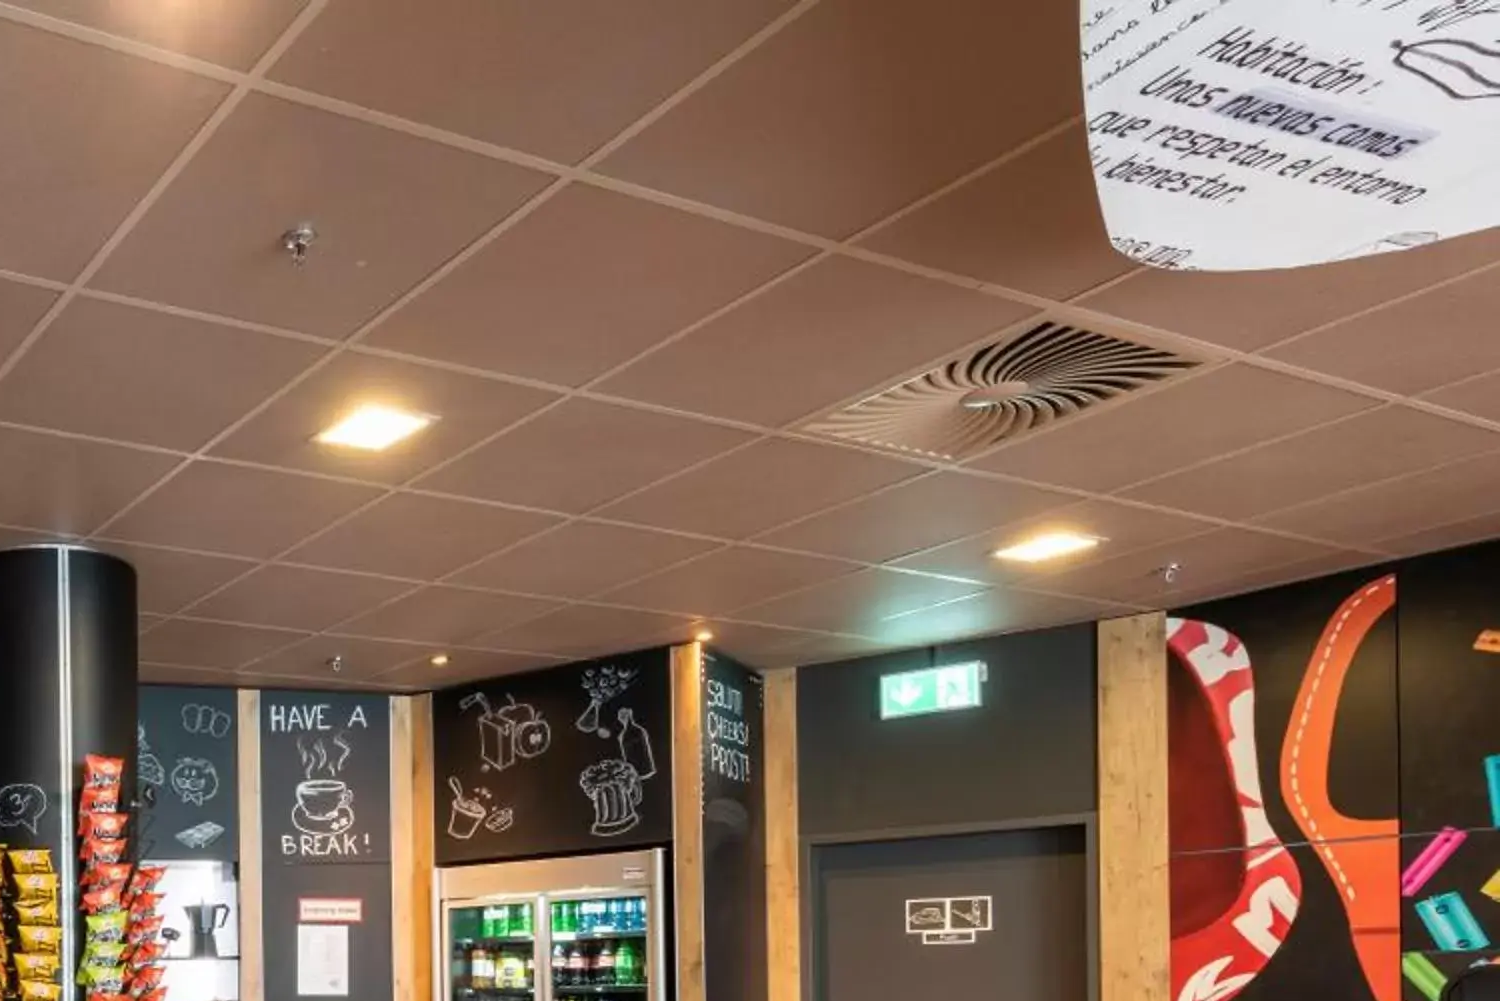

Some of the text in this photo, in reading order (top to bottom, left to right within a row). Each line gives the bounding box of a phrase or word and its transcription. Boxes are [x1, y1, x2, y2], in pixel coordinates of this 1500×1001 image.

[1139, 65, 1420, 157] Unas nuevas camas
[1143, 124, 1288, 170] respetan
[1277, 154, 1333, 179] el
[1308, 167, 1428, 205] entorno
[269, 703, 369, 733] HAVE A
[281, 832, 372, 856] BREAK!
